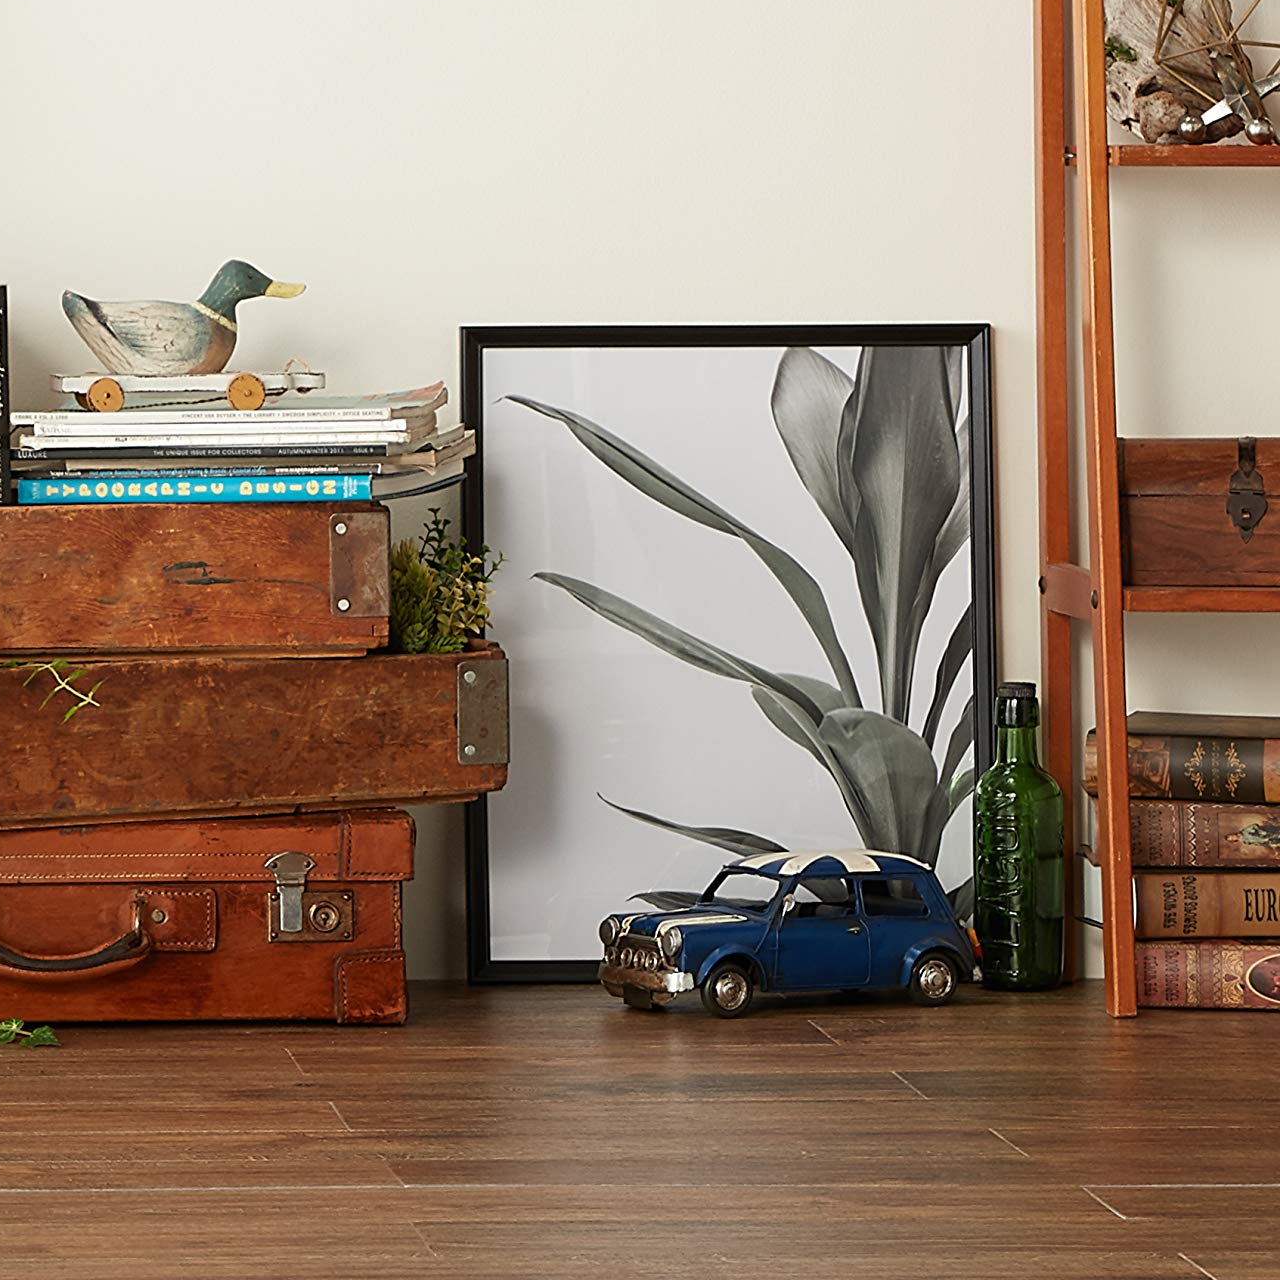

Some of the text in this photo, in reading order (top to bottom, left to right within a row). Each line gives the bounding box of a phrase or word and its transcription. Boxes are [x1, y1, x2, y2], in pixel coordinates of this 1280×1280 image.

[18, 451, 48, 459] LUXURE
[46, 481, 224, 497] TYPOGRAPHIC
[239, 480, 336, 496] DESIGN
[1243, 888, 1280, 922] EUR
